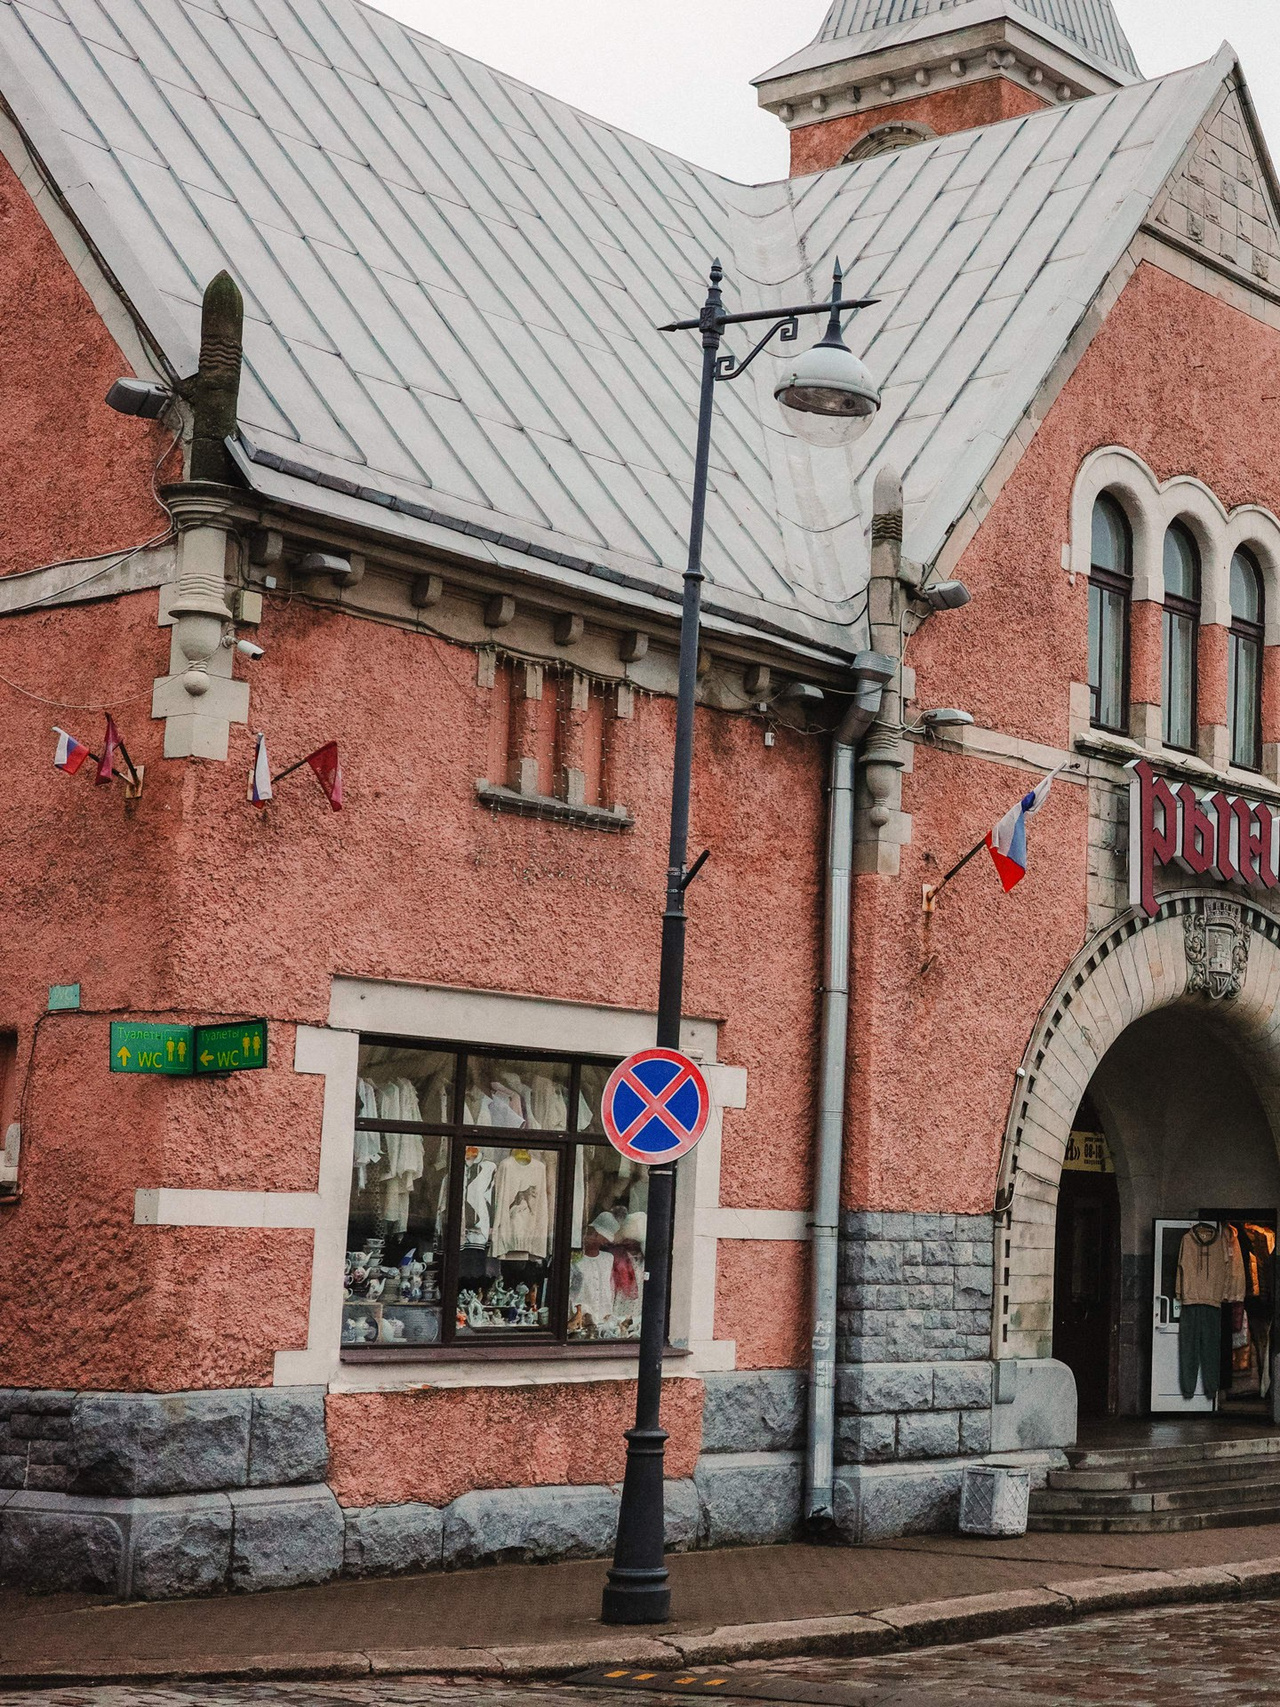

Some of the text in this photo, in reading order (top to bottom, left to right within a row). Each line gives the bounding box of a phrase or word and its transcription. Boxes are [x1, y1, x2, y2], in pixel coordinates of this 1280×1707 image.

[117, 1026, 164, 1042] Туалеты
[200, 1029, 240, 1045] Туалеты
[138, 1051, 163, 1068] WC
[217, 1049, 239, 1068] WC
